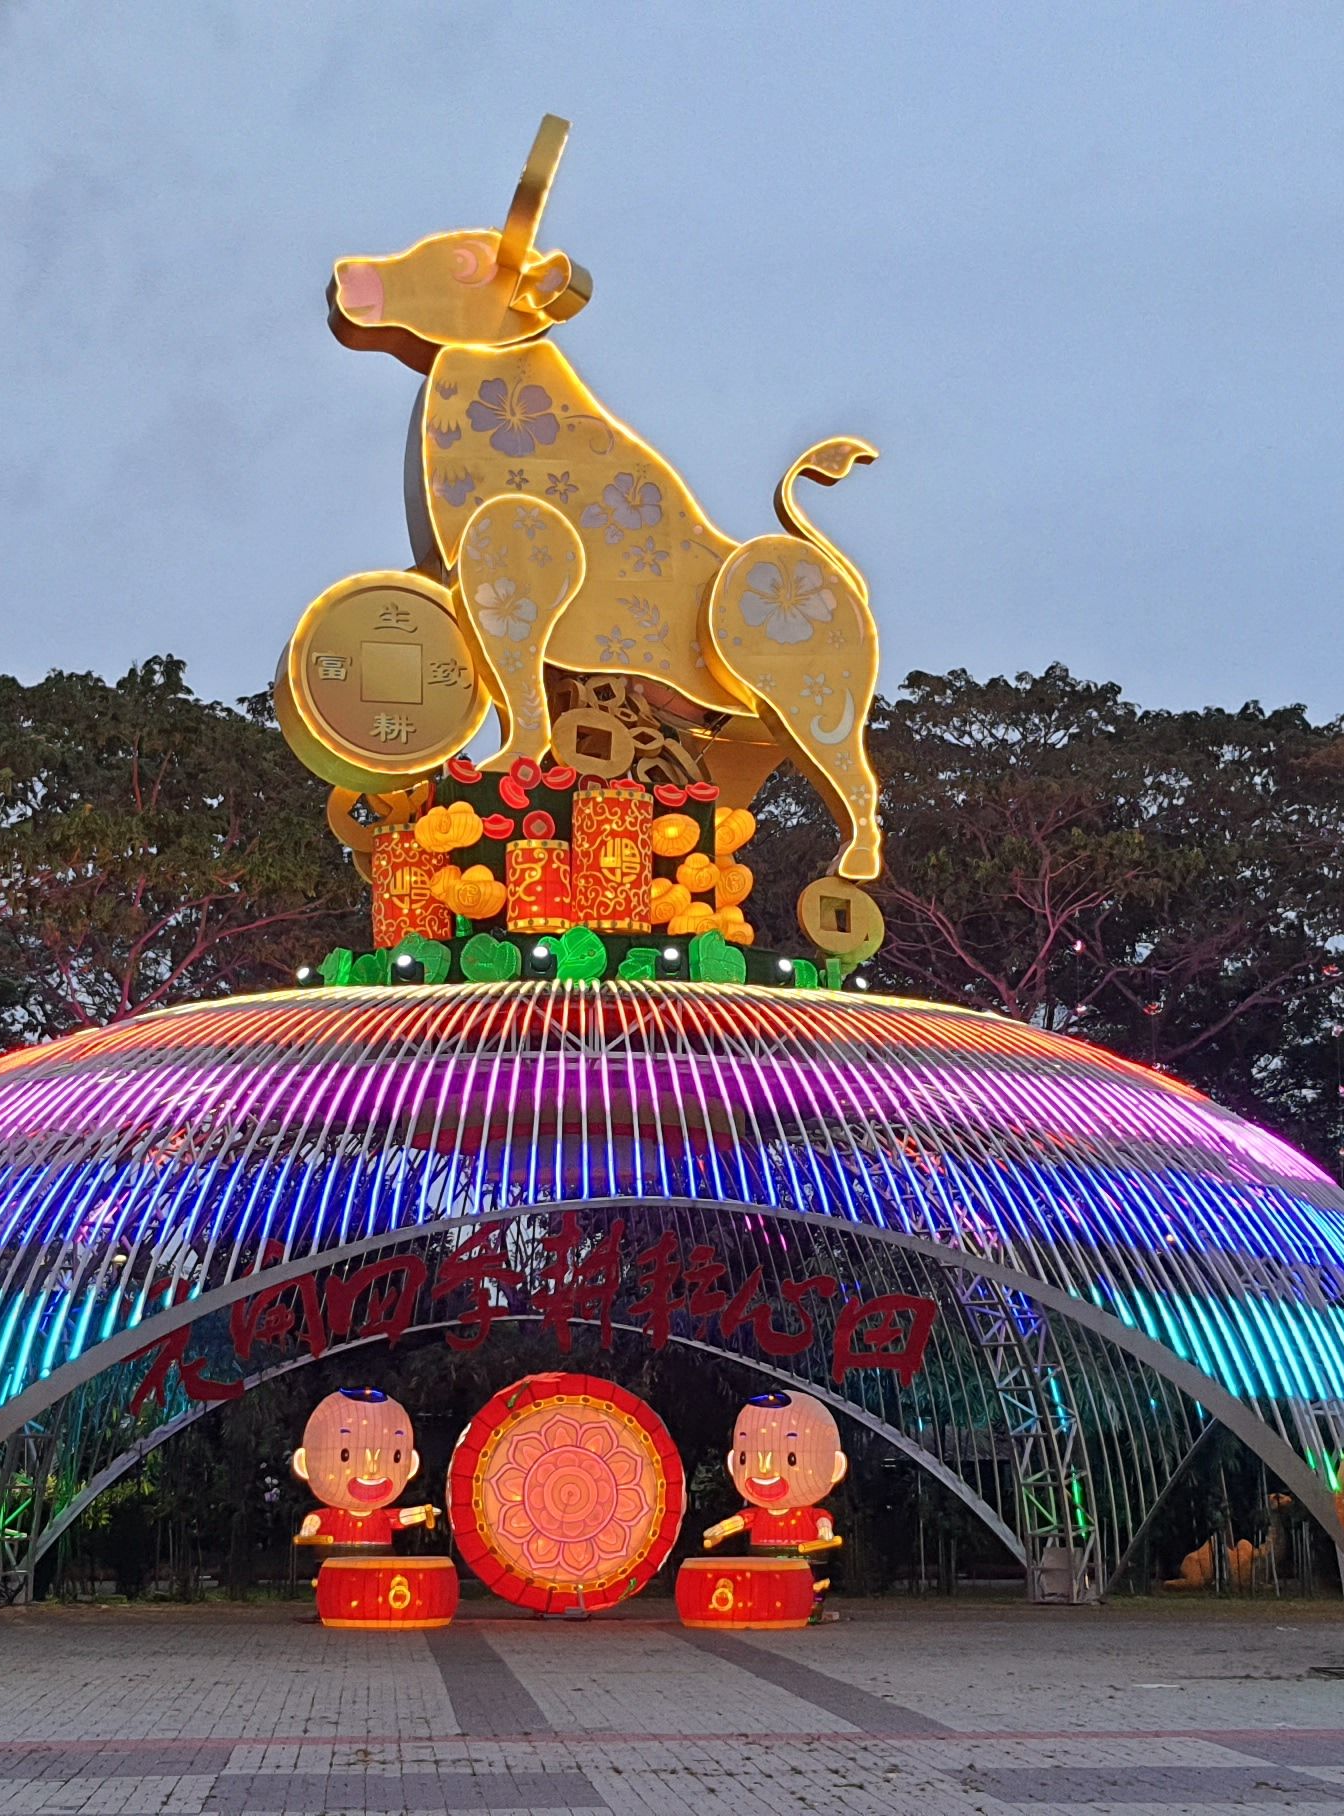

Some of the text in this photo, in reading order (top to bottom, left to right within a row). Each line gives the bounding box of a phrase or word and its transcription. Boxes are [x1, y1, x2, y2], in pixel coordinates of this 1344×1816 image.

[311, 603, 472, 744] 生 耕 致 富
